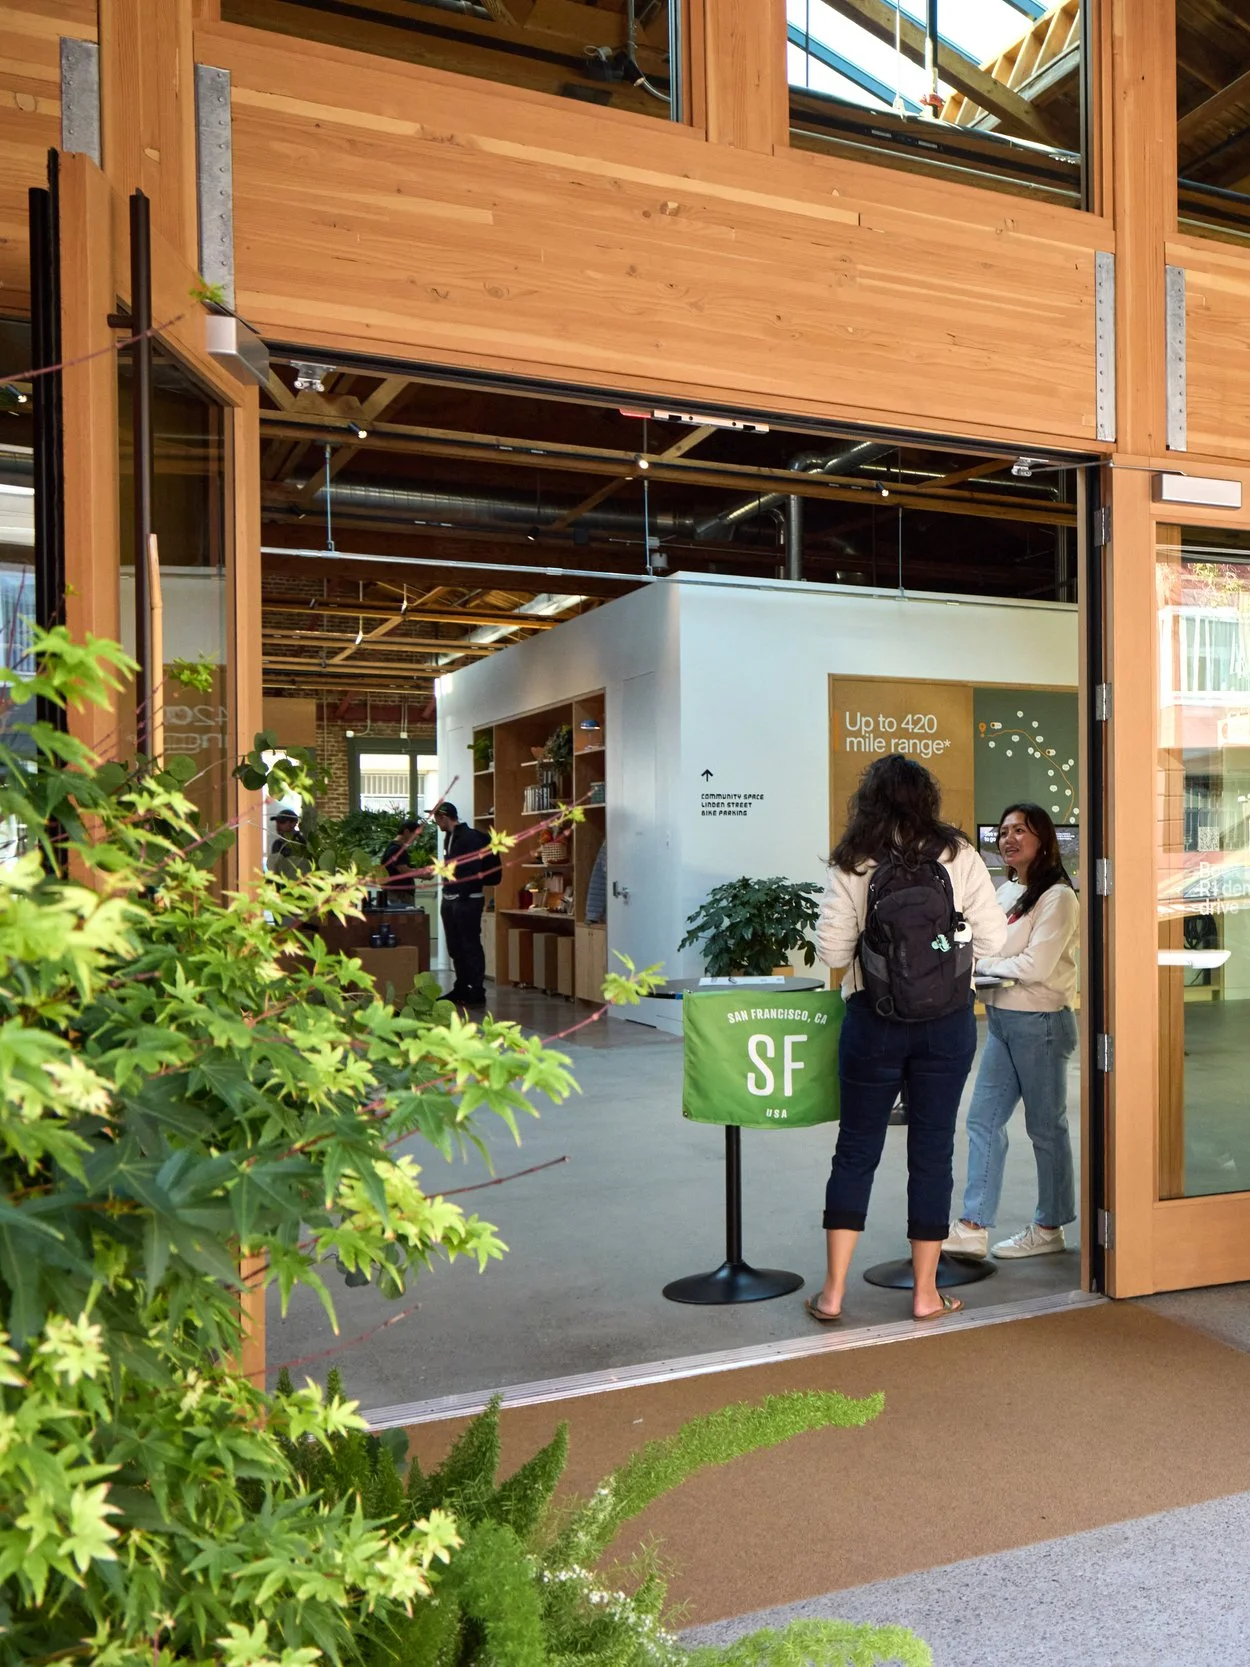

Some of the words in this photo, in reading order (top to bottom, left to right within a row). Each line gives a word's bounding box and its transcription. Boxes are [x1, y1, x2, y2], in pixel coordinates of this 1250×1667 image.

[845, 711, 874, 735] Up
[878, 713, 897, 732] to
[901, 714, 938, 734] 420
[846, 733, 886, 753] mile
[1199, 898, 1239, 915] drive
[727, 1010, 749, 1024] SAN
[750, 1008, 811, 1023] FRANCISCO,
[813, 1012, 828, 1025] CA
[747, 1033, 808, 1097] SF
[765, 1108, 788, 1119] USA
